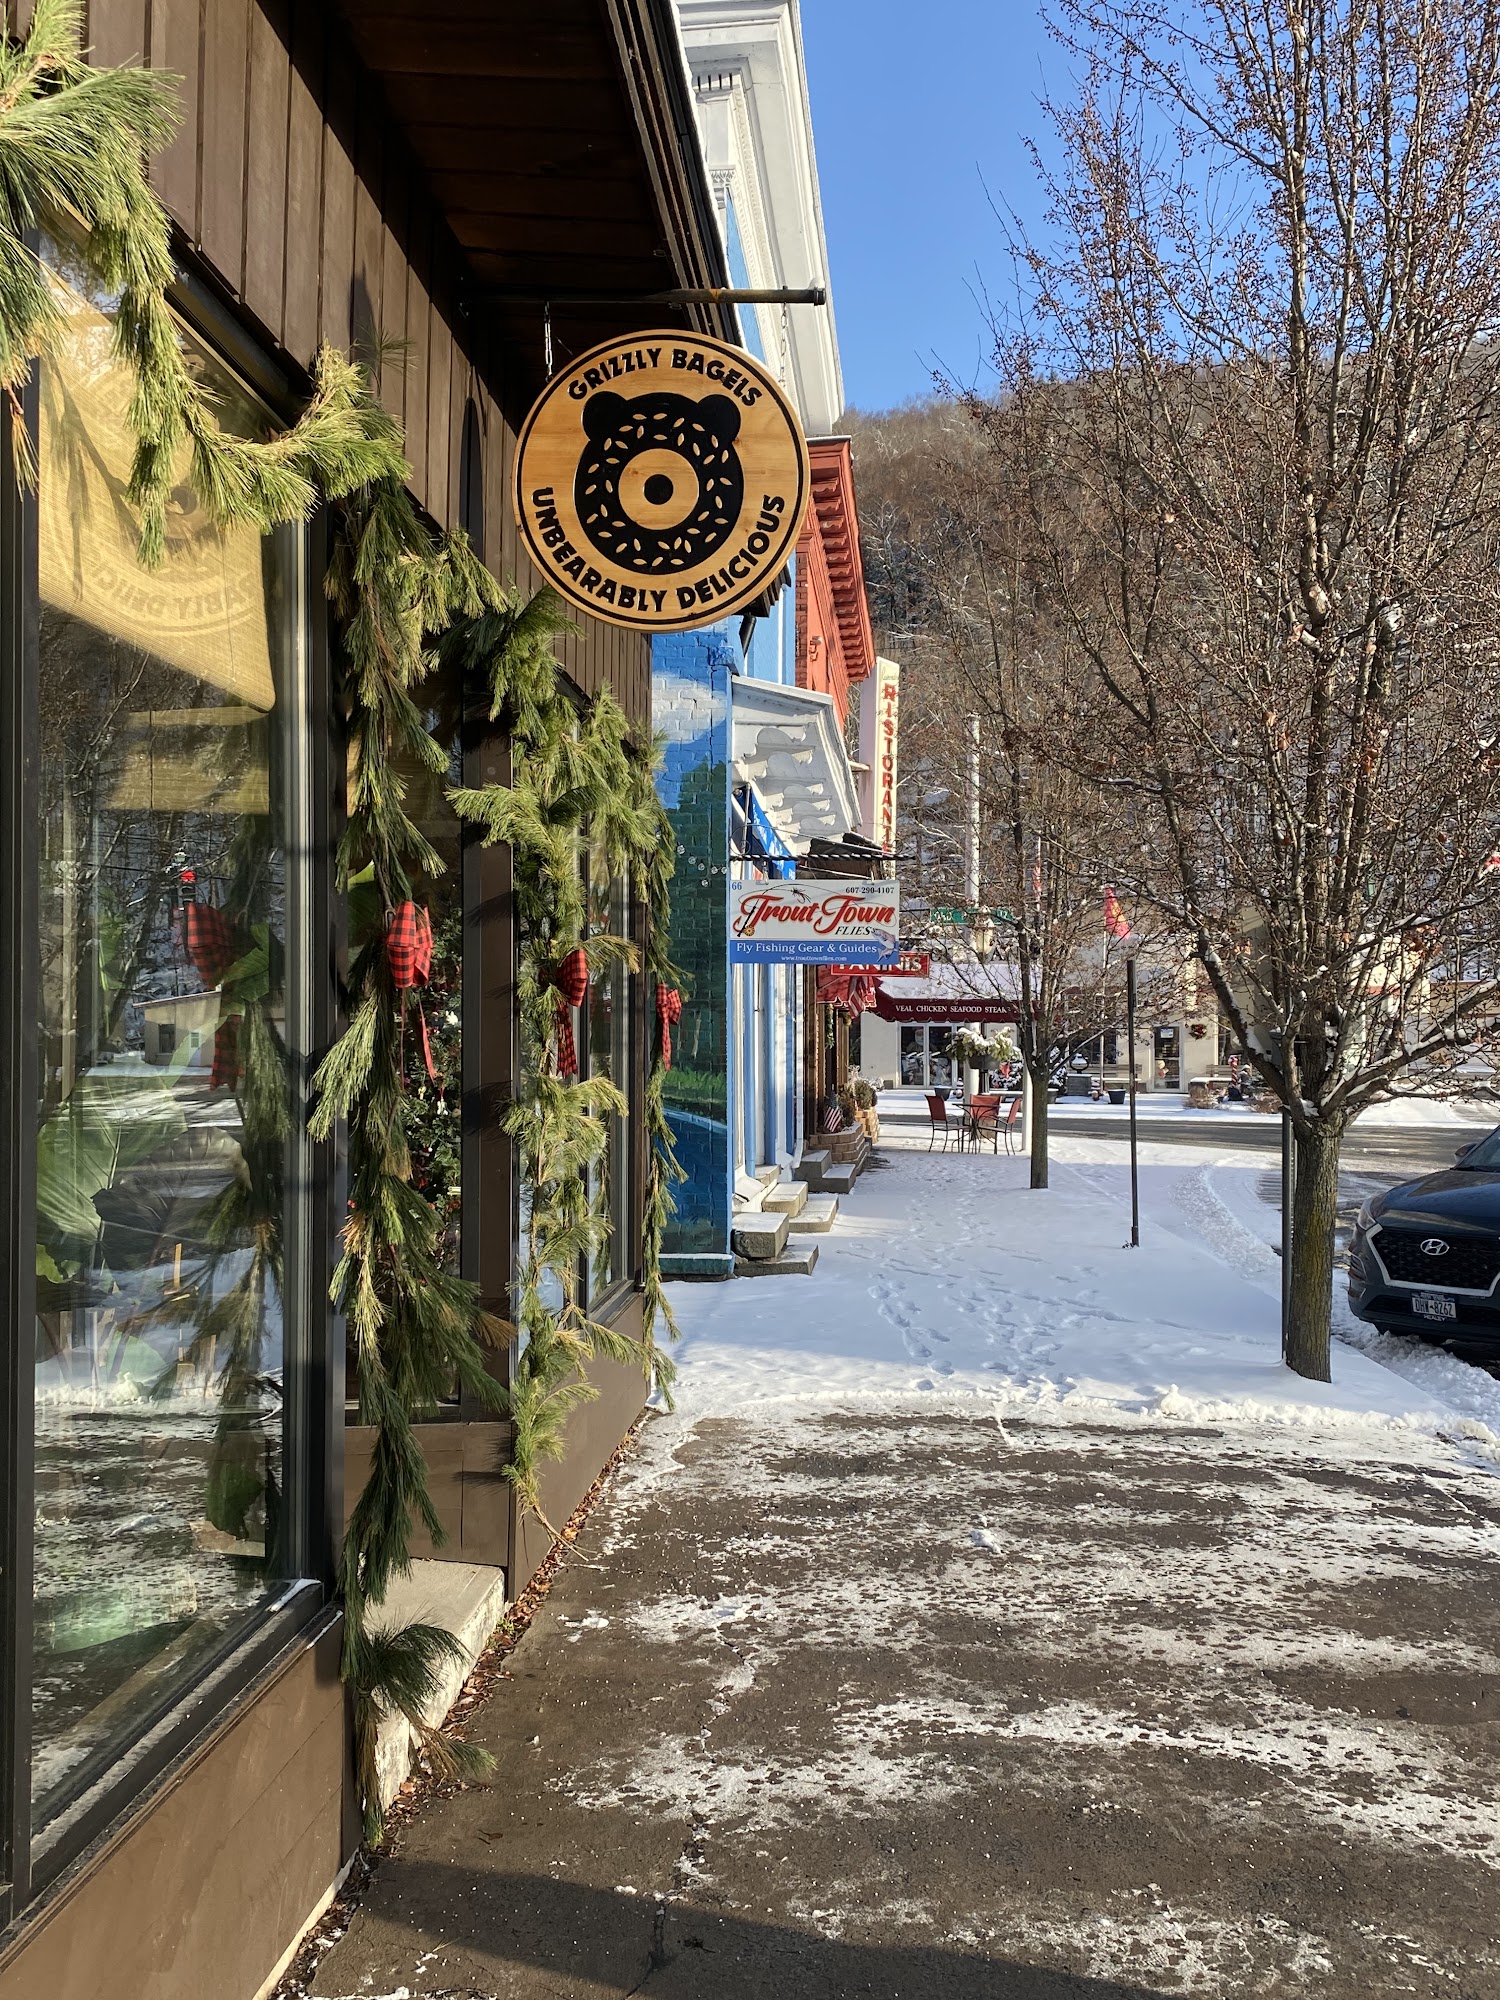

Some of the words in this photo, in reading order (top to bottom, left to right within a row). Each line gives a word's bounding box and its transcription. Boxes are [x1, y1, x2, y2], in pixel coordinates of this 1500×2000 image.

[568, 347, 662, 400] GRIZZLY
[671, 348, 763, 406] BAGELS
[532, 486, 668, 612] UNBEARABLY
[676, 494, 786, 610] DELICIOUS
[881, 682, 896, 853] RISTORANTE
[731, 881, 743, 891] 66
[845, 886, 895, 894] 607-290-4107
[732, 894, 820, 933] Trout
[813, 894, 896, 934] Town
[834, 926, 872, 936] FLIES
[736, 943, 753, 955] Fly
[756, 942, 795, 955] Fishing
[797, 943, 824, 953] Gear
[828, 943, 836, 953] &
[840, 942, 877, 953] Guides
[915, 1005, 948, 1013] CHICKEN
[950, 1005, 983, 1013] SEAFOOD
